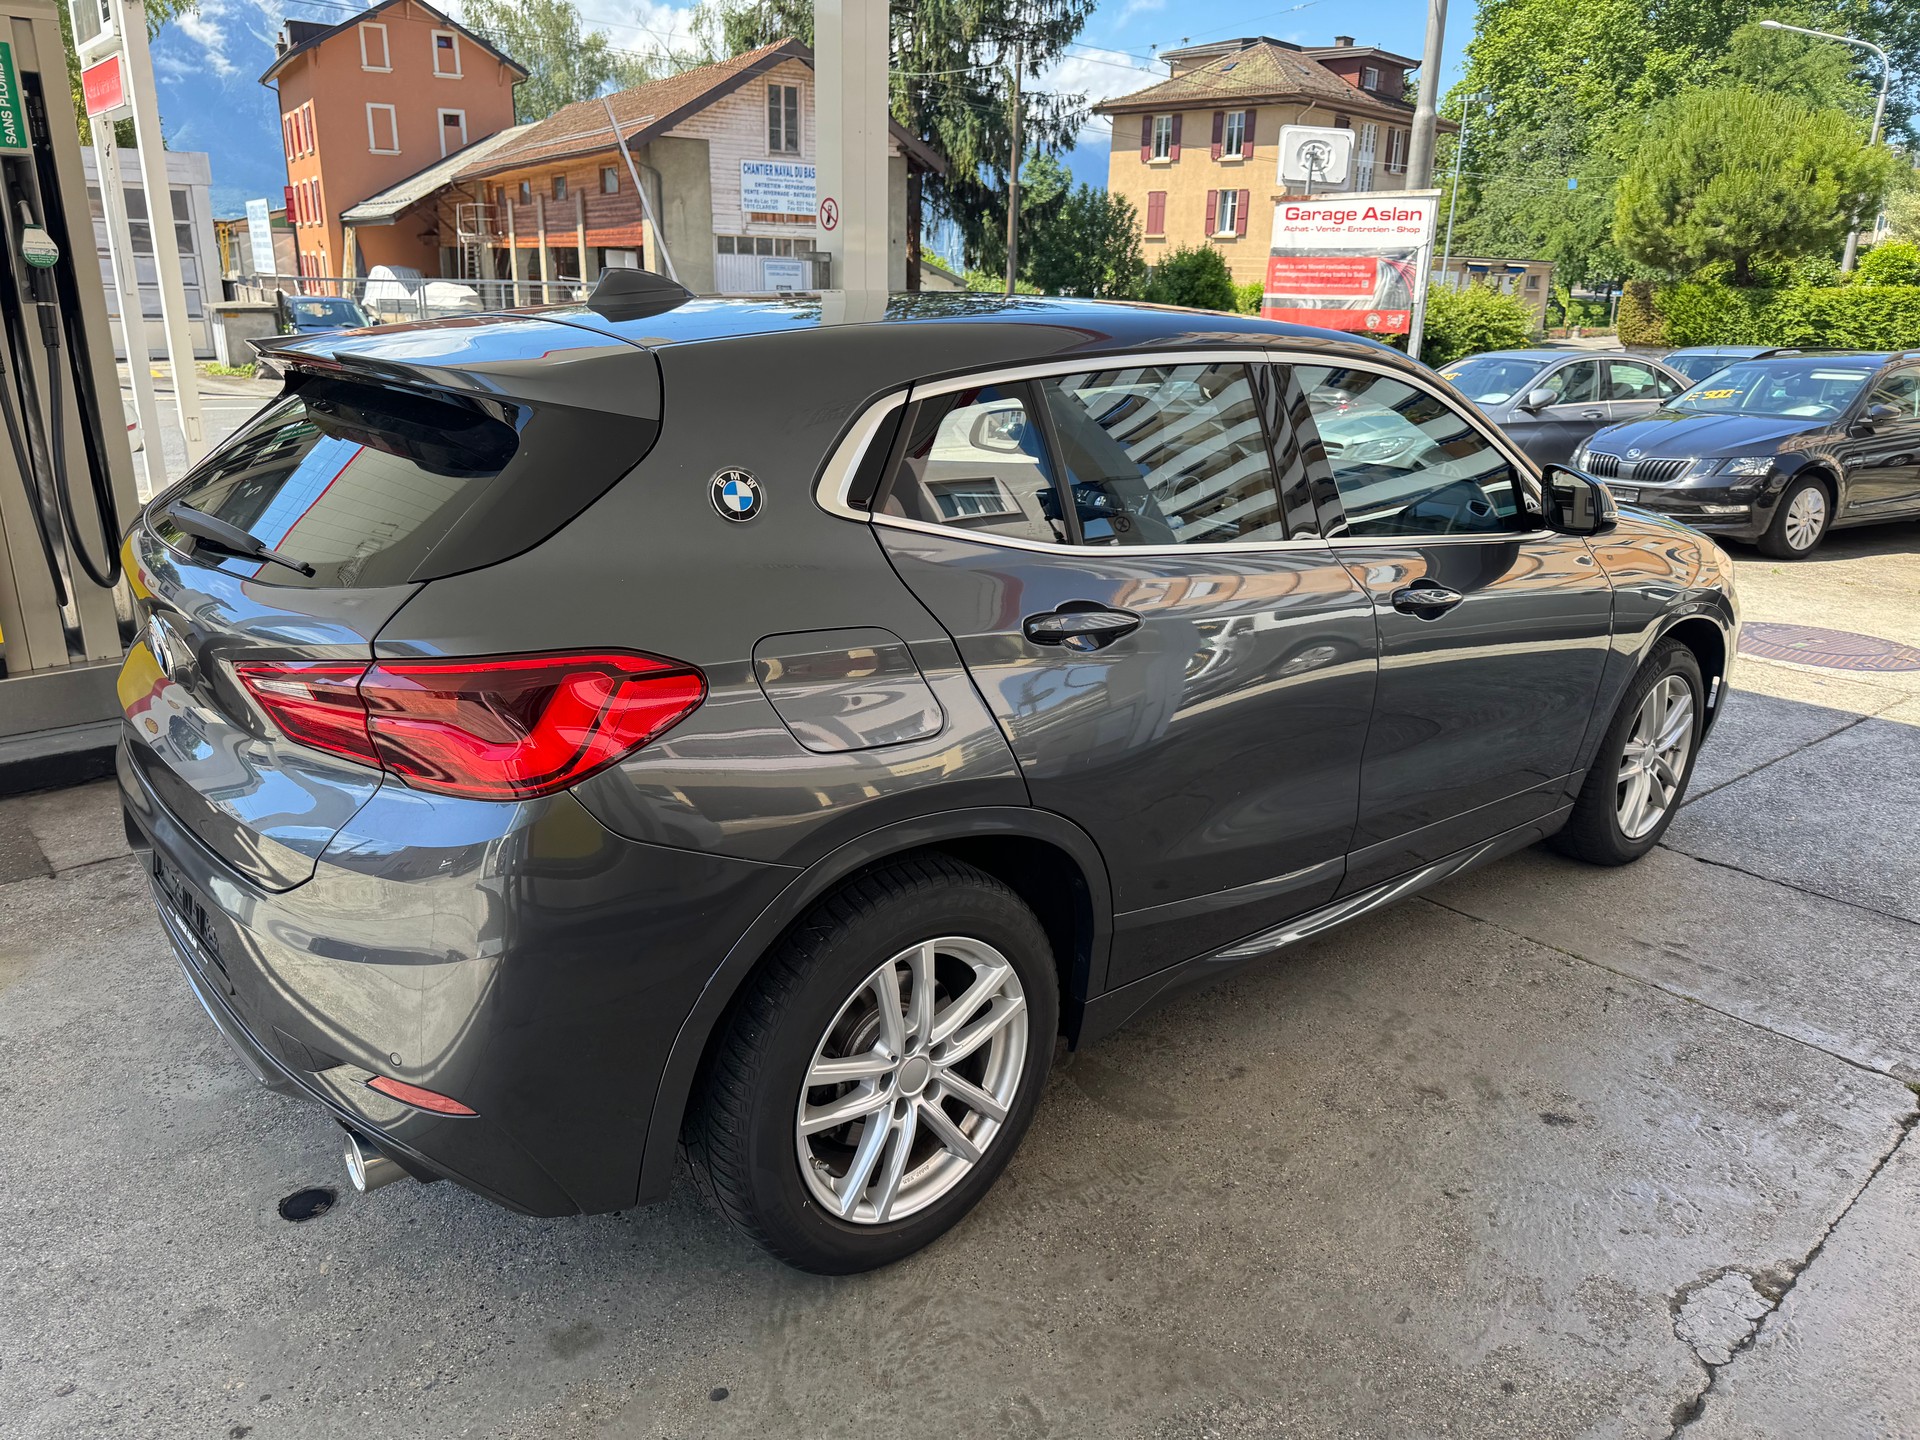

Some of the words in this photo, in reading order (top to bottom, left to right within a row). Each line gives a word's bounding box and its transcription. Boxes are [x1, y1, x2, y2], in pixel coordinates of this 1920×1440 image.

[1, 110, 17, 145] SANS
[743, 162, 773, 176] CHANTIER
[774, 165, 794, 178] NAVAL
[795, 166, 803, 178] DU
[1285, 206, 1357, 225] Garage
[1361, 206, 1422, 221] Aslan
[1396, 226, 1421, 234] Shop
[716, 472, 757, 489] BMW
